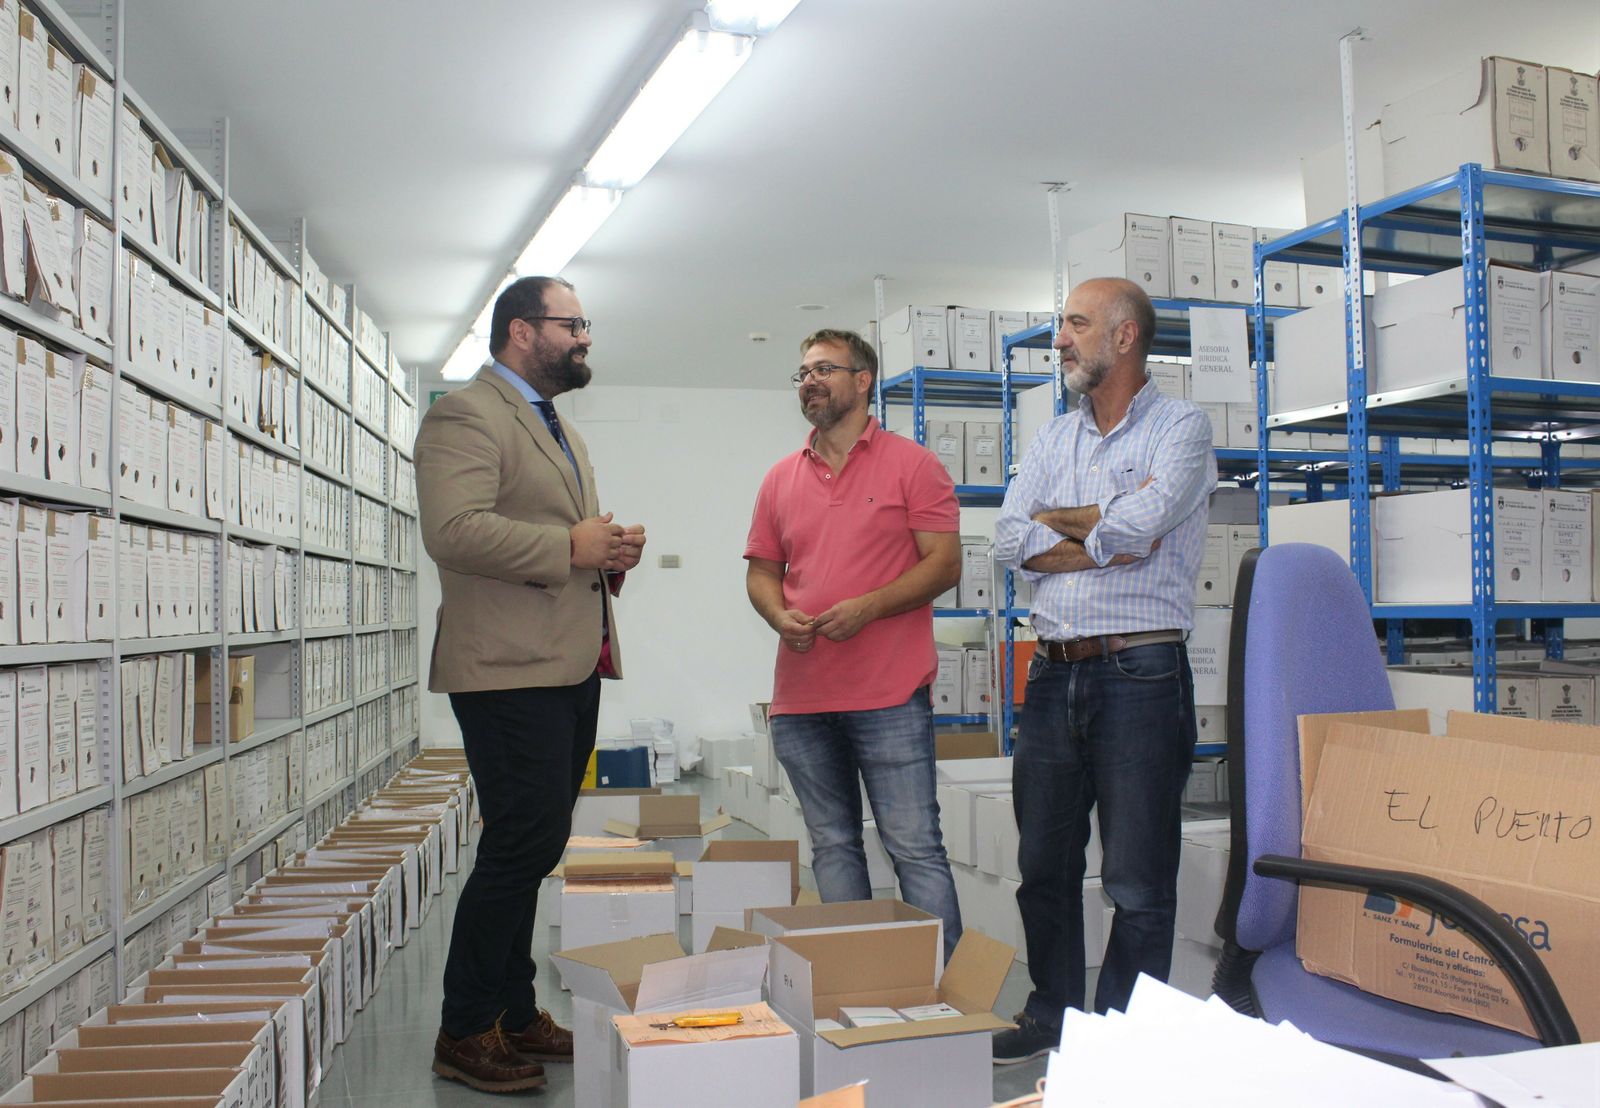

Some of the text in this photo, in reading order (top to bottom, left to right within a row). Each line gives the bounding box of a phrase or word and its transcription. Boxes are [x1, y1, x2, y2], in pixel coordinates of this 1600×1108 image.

[1199, 364, 1234, 373] GENERAL
[1190, 656, 1214, 664] RIDICA
[1193, 666, 1218, 675] NERAL
[1384, 789, 1438, 830] EL
[1373, 913, 1393, 924] SANZ
[1401, 920, 1421, 930] SANZ
[1389, 933, 1495, 967] Formularios del Centro
[1445, 961, 1451, 970] y
[1452, 964, 1486, 978] oficinas:
